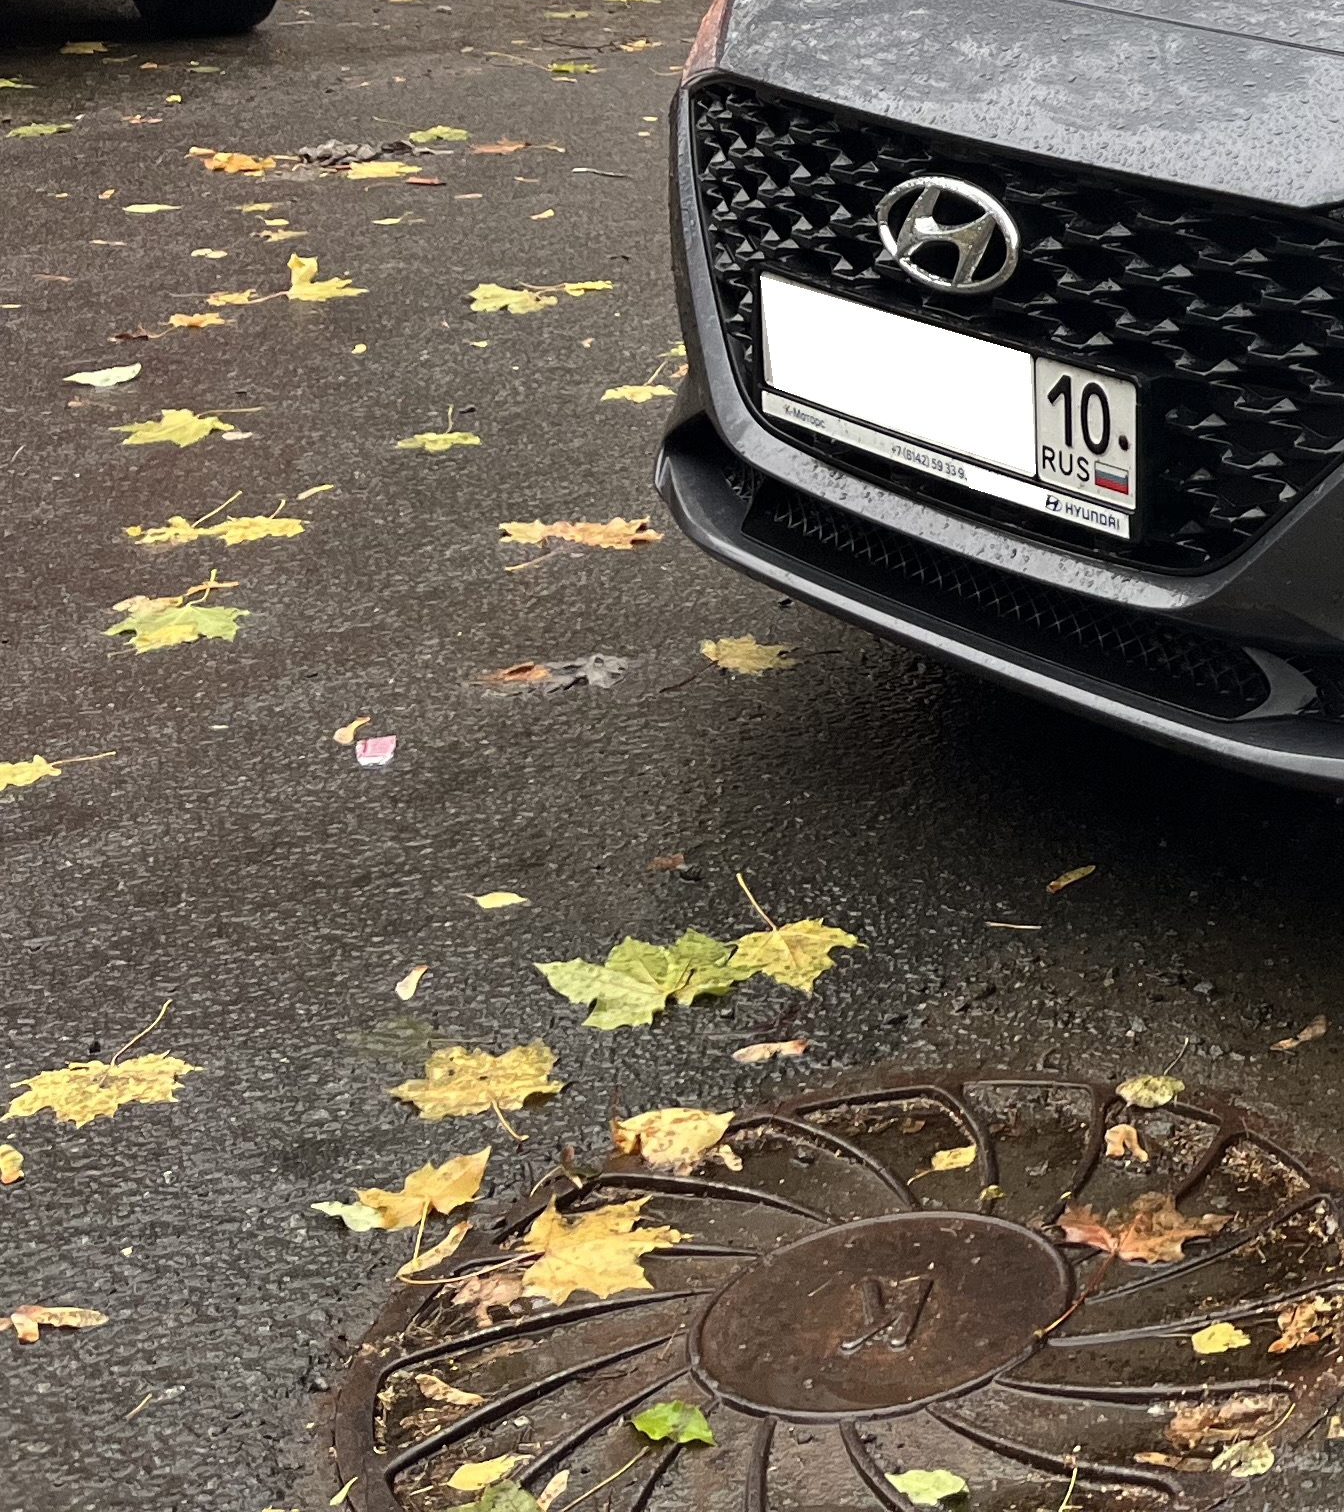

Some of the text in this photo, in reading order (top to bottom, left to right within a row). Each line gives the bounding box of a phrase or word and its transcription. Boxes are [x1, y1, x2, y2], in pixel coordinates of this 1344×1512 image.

[1047, 374, 1111, 456] 10
[1042, 445, 1090, 482] RUS
[1065, 501, 1120, 531] HYUNDAI
